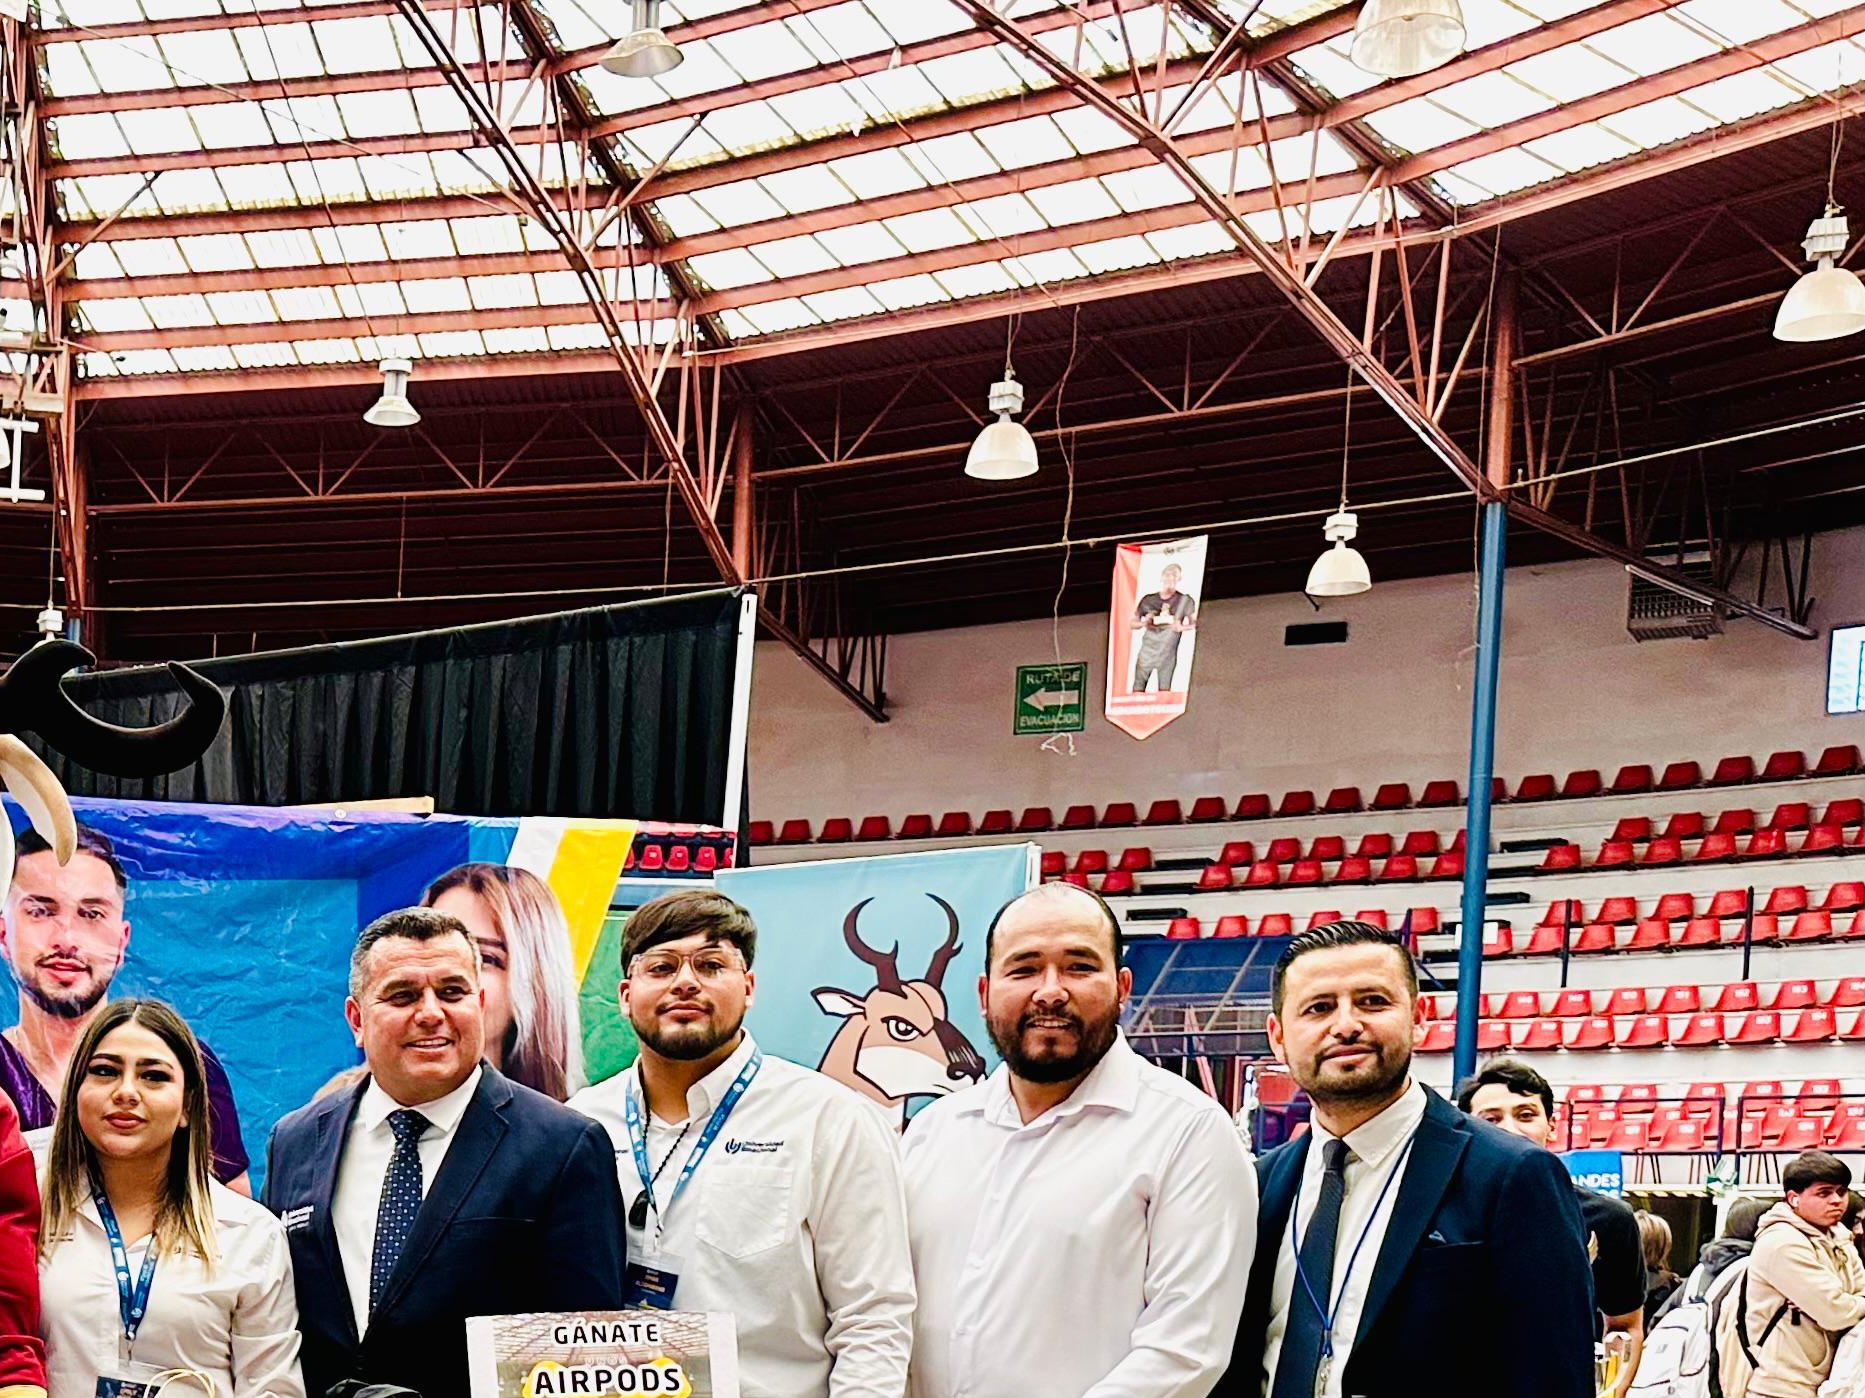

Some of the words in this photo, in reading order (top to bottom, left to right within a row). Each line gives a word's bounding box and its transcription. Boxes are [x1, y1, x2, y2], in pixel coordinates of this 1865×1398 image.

[1026, 671, 1060, 684] RUTA
[1063, 671, 1081, 682] DE
[554, 1320, 659, 1345] GÁNATE
[535, 1368, 680, 1395] AIRPODS
